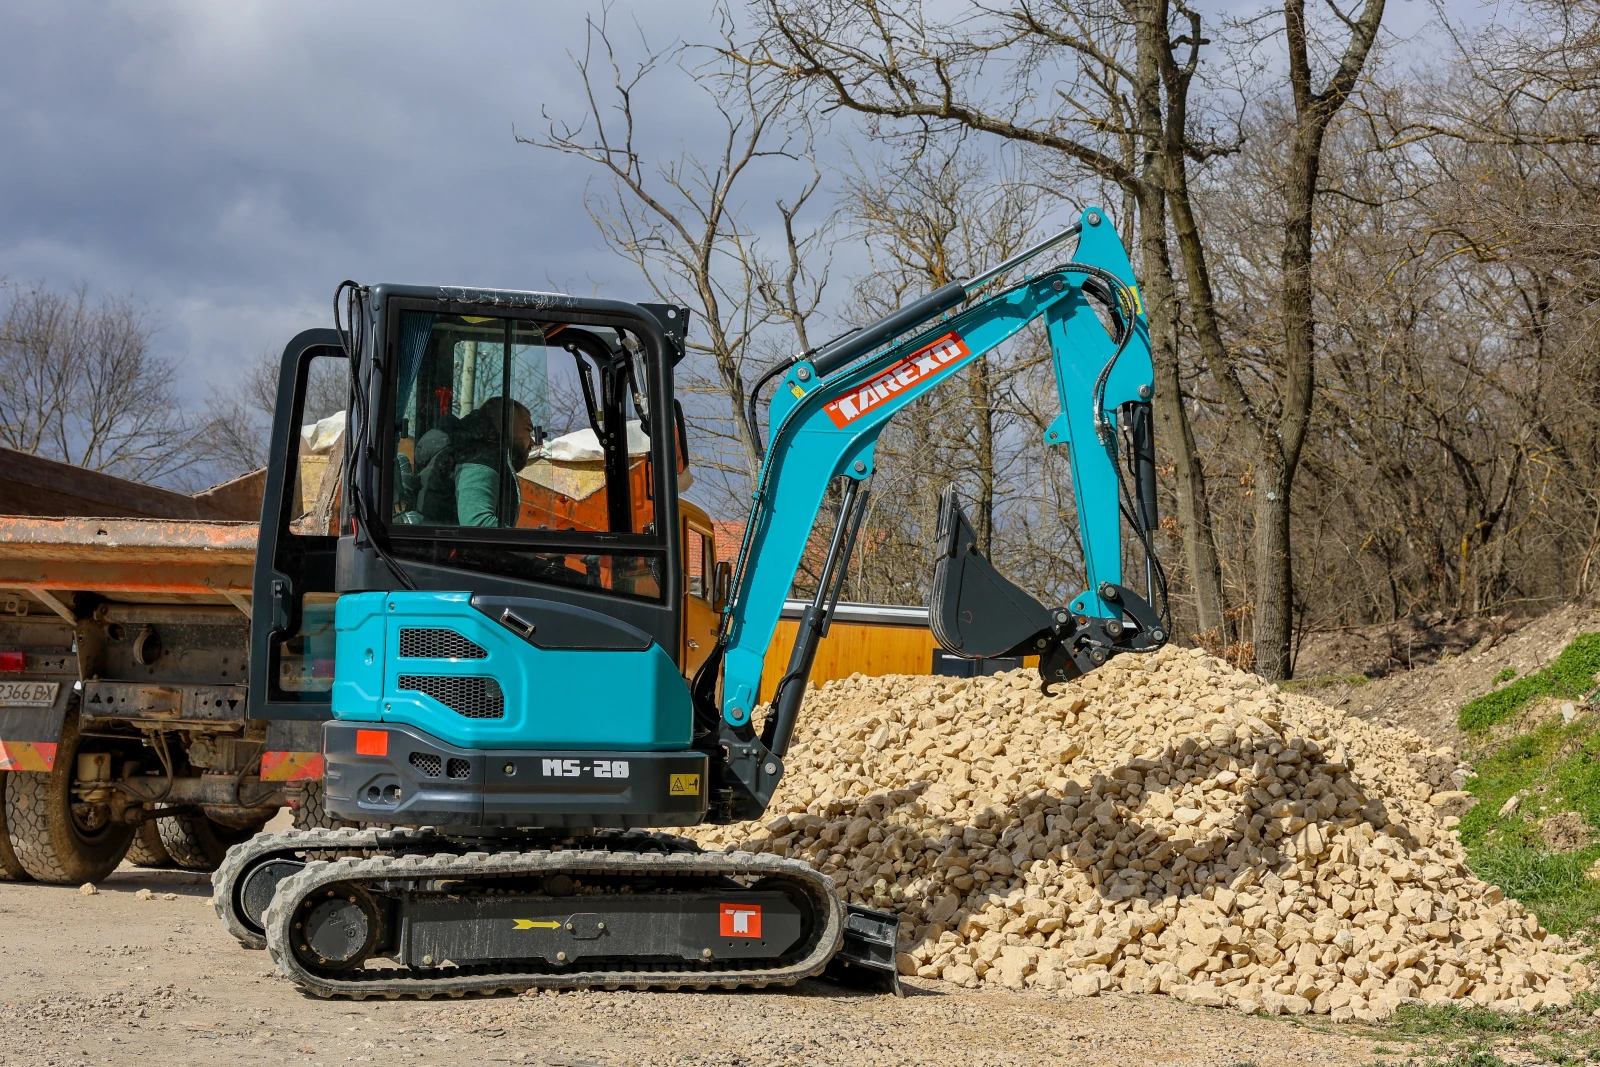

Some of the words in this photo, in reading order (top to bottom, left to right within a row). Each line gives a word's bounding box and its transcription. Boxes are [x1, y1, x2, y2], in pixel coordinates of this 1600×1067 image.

[829, 338, 962, 421] TAREXO
[33, 685, 56, 701] BX
[541, 758, 630, 778] MS-28
